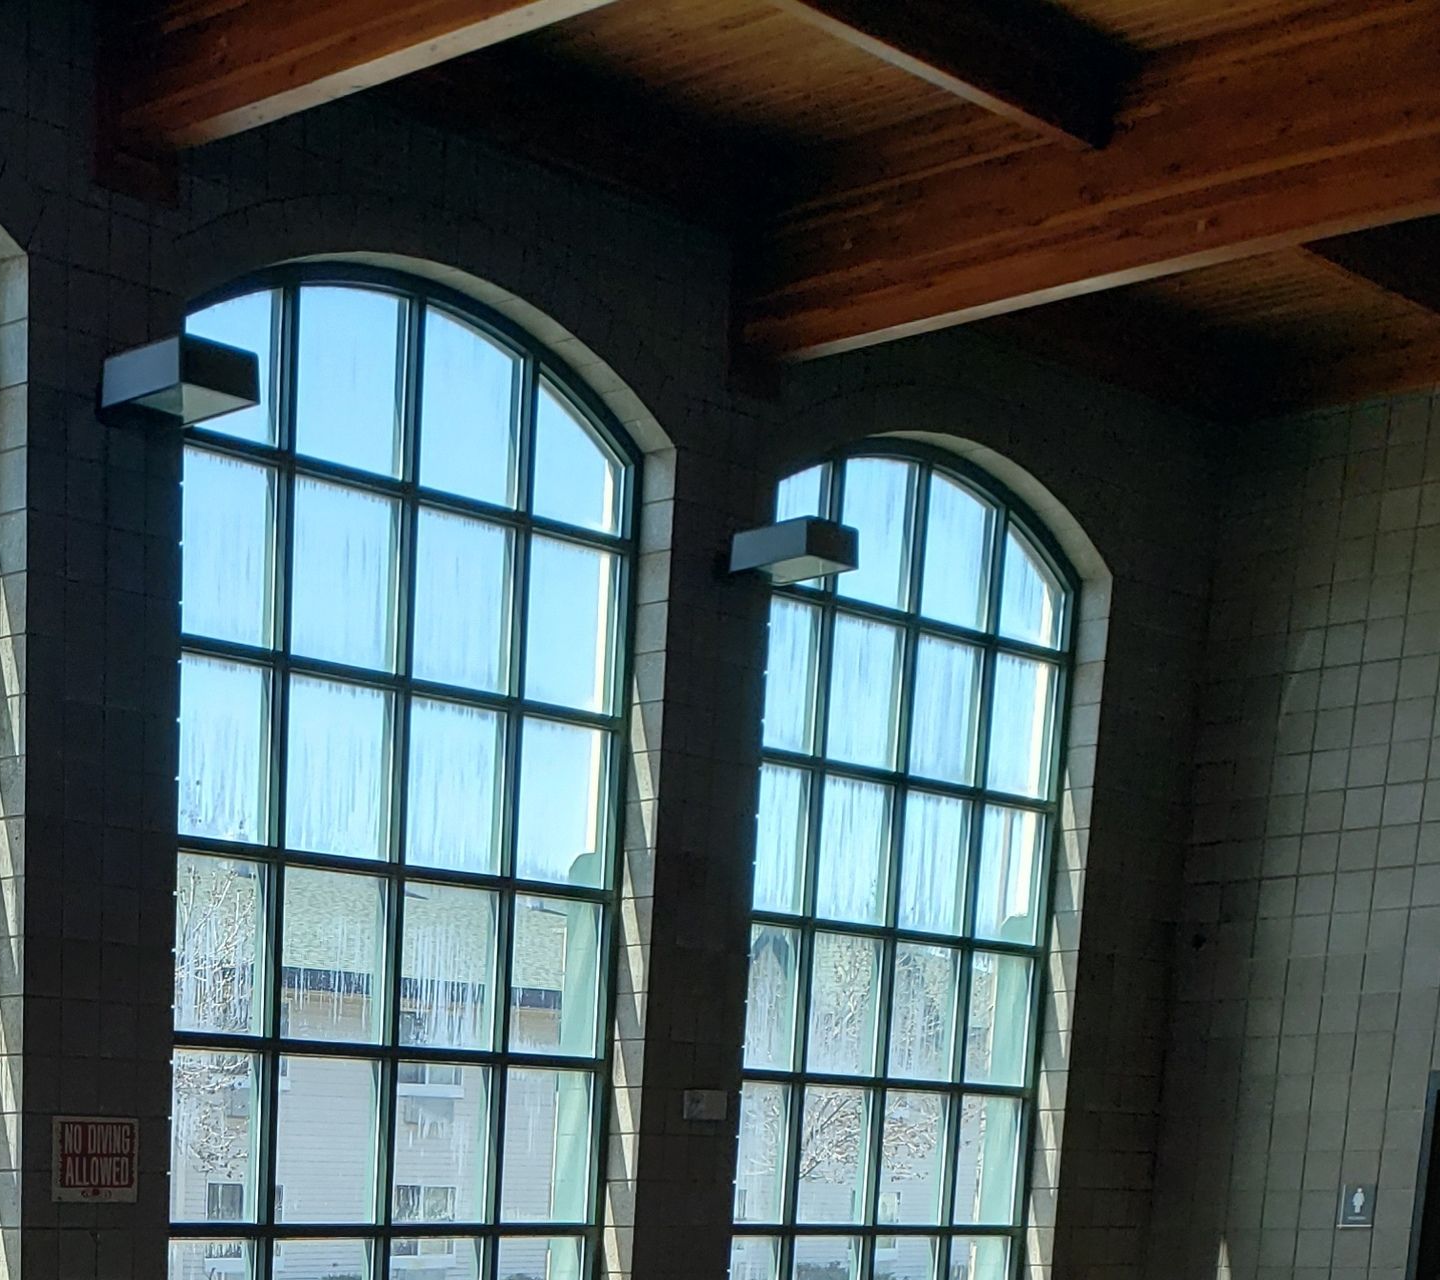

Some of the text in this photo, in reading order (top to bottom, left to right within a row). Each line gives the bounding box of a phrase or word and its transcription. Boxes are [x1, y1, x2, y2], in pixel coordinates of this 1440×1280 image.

[64, 1123, 130, 1154] NO DIVING
[65, 1156, 129, 1186] ALLOWED
